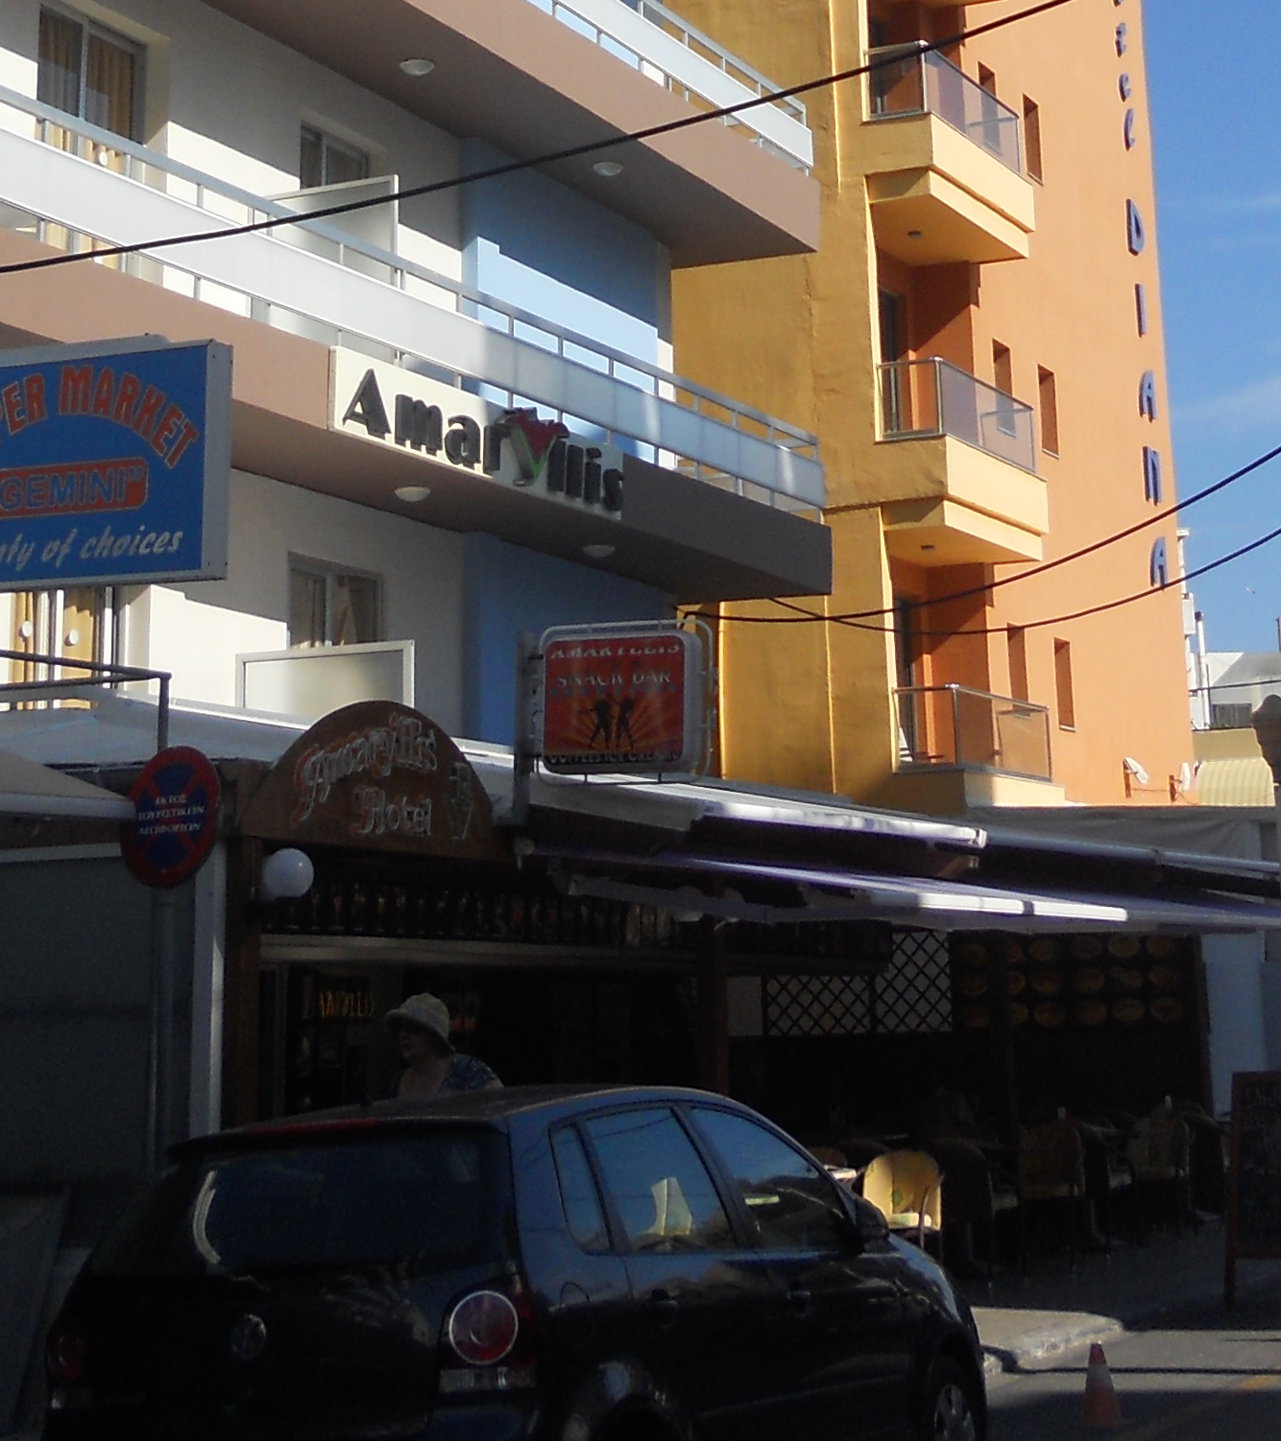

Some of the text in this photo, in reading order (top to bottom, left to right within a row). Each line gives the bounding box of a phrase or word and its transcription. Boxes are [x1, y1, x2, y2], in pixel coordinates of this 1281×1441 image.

[58, 363, 200, 469] MARKET
[1125, 198, 1169, 592] DIANA
[41, 528, 79, 568] of
[80, 524, 184, 559] choices
